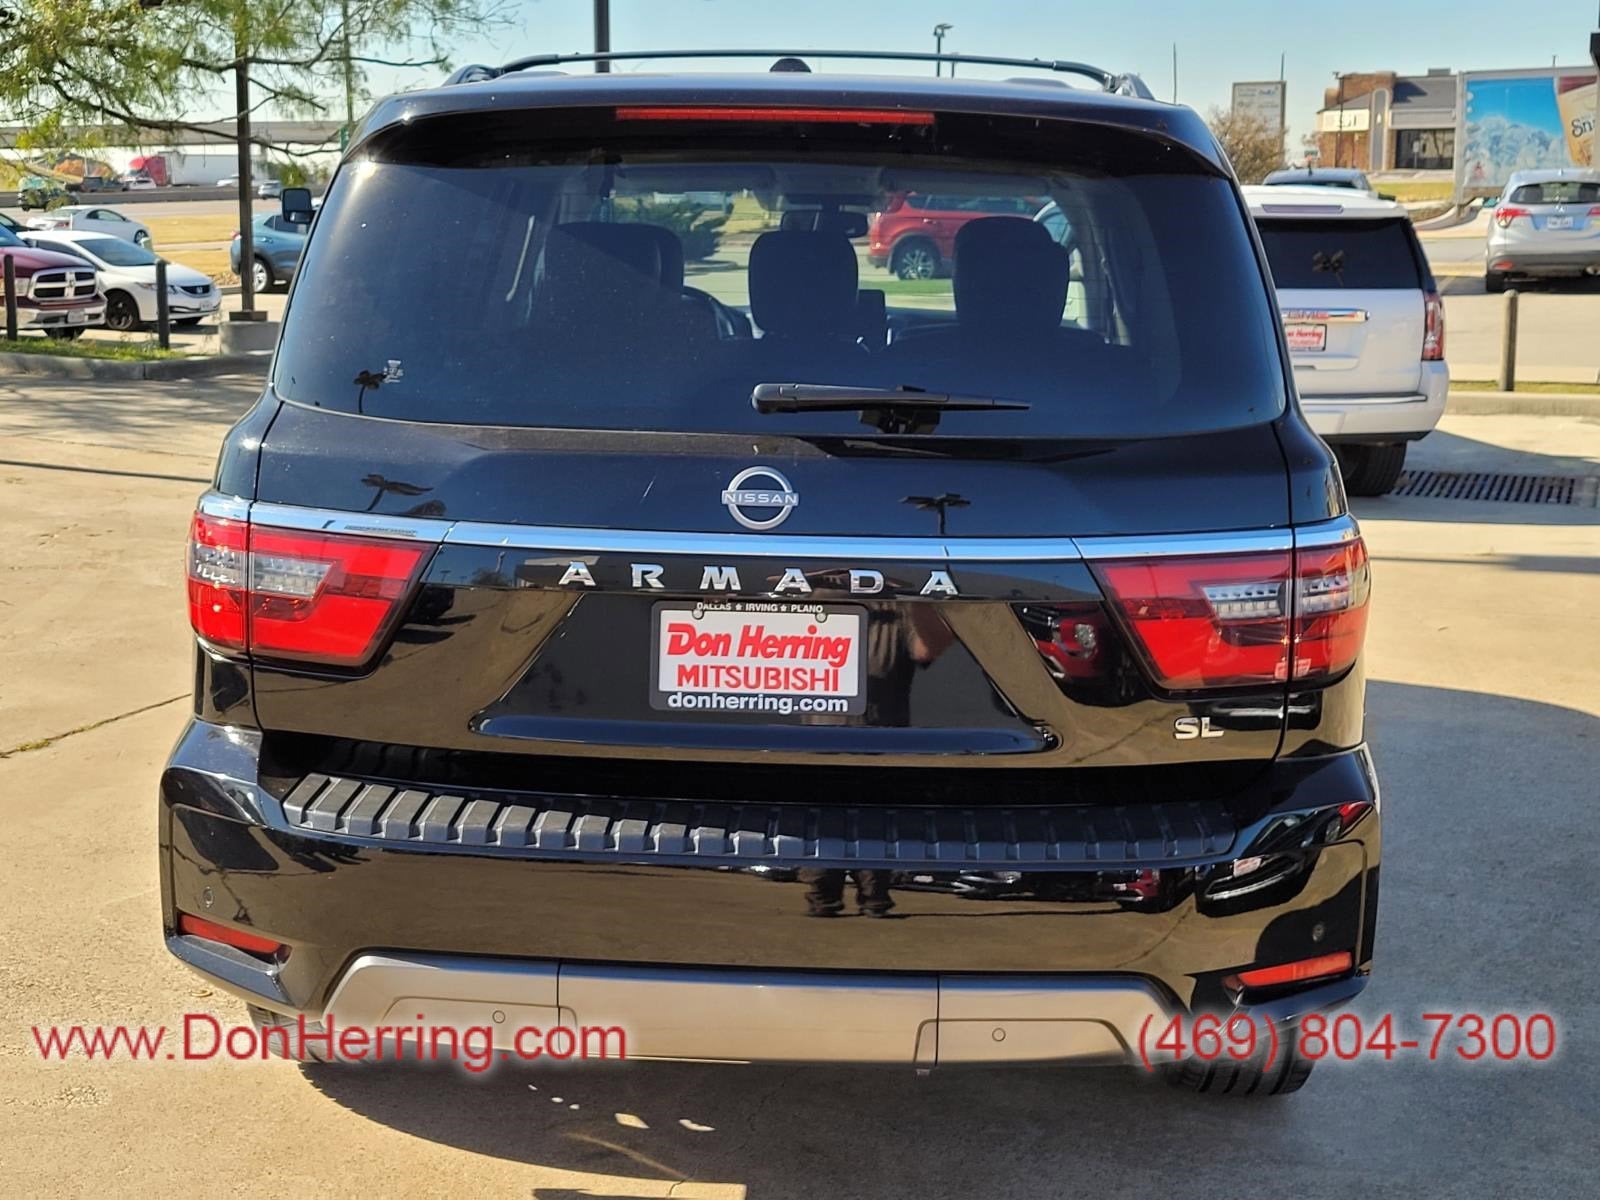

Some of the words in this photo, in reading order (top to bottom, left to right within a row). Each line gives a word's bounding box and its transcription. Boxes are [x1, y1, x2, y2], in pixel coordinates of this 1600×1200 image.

[725, 493, 797, 504] NISSAN
[558, 560, 960, 596] ARMADA
[697, 602, 731, 611] DALLAS
[745, 603, 778, 612] IRVING
[791, 604, 823, 613] PLANO
[667, 623, 732, 656] Don
[737, 625, 851, 668] Herring
[677, 664, 839, 691] MITSUBISHI
[668, 692, 848, 715] donherring.com
[1174, 717, 1225, 740] SL
